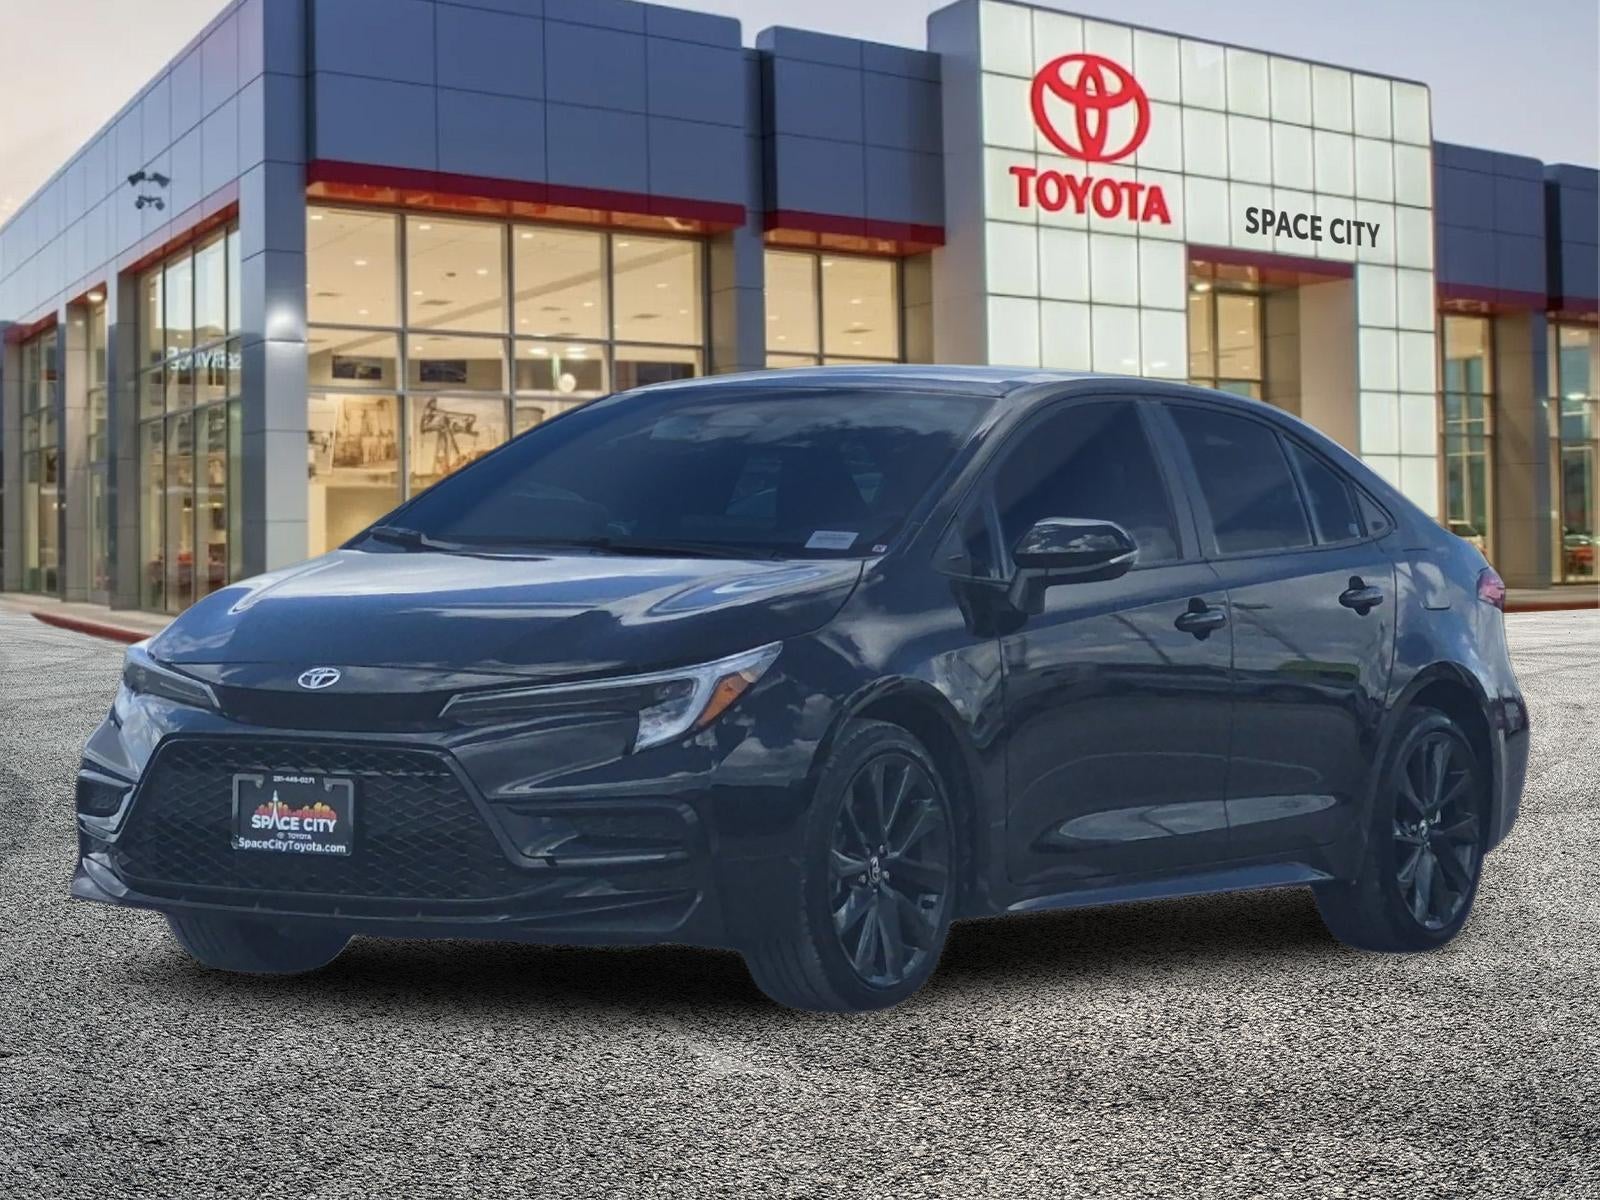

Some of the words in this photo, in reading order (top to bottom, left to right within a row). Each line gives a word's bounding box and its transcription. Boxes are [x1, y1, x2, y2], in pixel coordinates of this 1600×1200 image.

[1009, 166, 1171, 224] TOYOTA
[1245, 207, 1323, 241] SPACE
[1329, 218, 1380, 248] CITY
[251, 814, 300, 830] SPACE
[303, 818, 337, 832] CITY
[238, 837, 346, 853] SpaceCityToyota.com
[288, 832, 312, 840] TOYOTA
